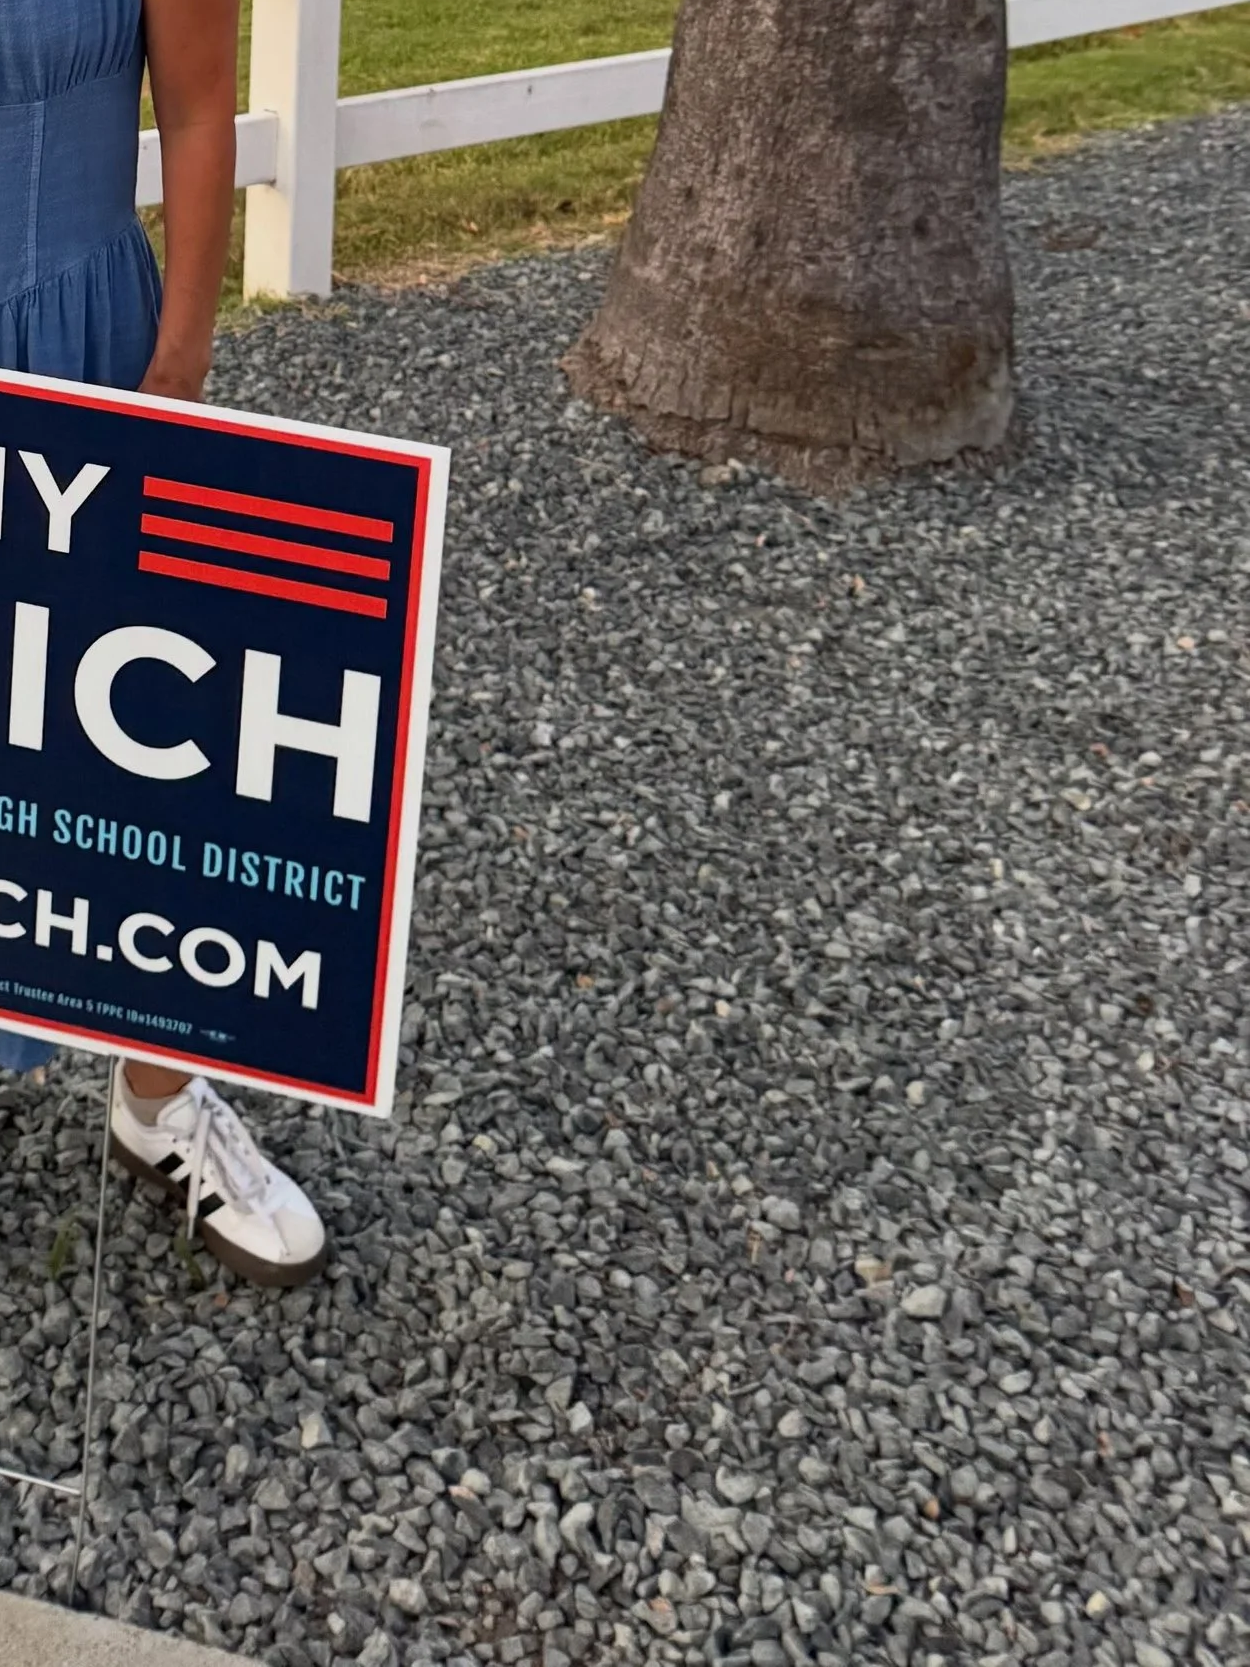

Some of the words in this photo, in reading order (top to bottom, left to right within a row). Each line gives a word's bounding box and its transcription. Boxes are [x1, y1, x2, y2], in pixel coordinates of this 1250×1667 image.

[52, 809, 187, 873] SCHOOL
[202, 842, 366, 910] DISTRICT
[13, 982, 54, 1003] Trustee
[56, 992, 83, 1010] Area
[85, 998, 94, 1013] 5
[97, 1001, 124, 1020] FPPC
